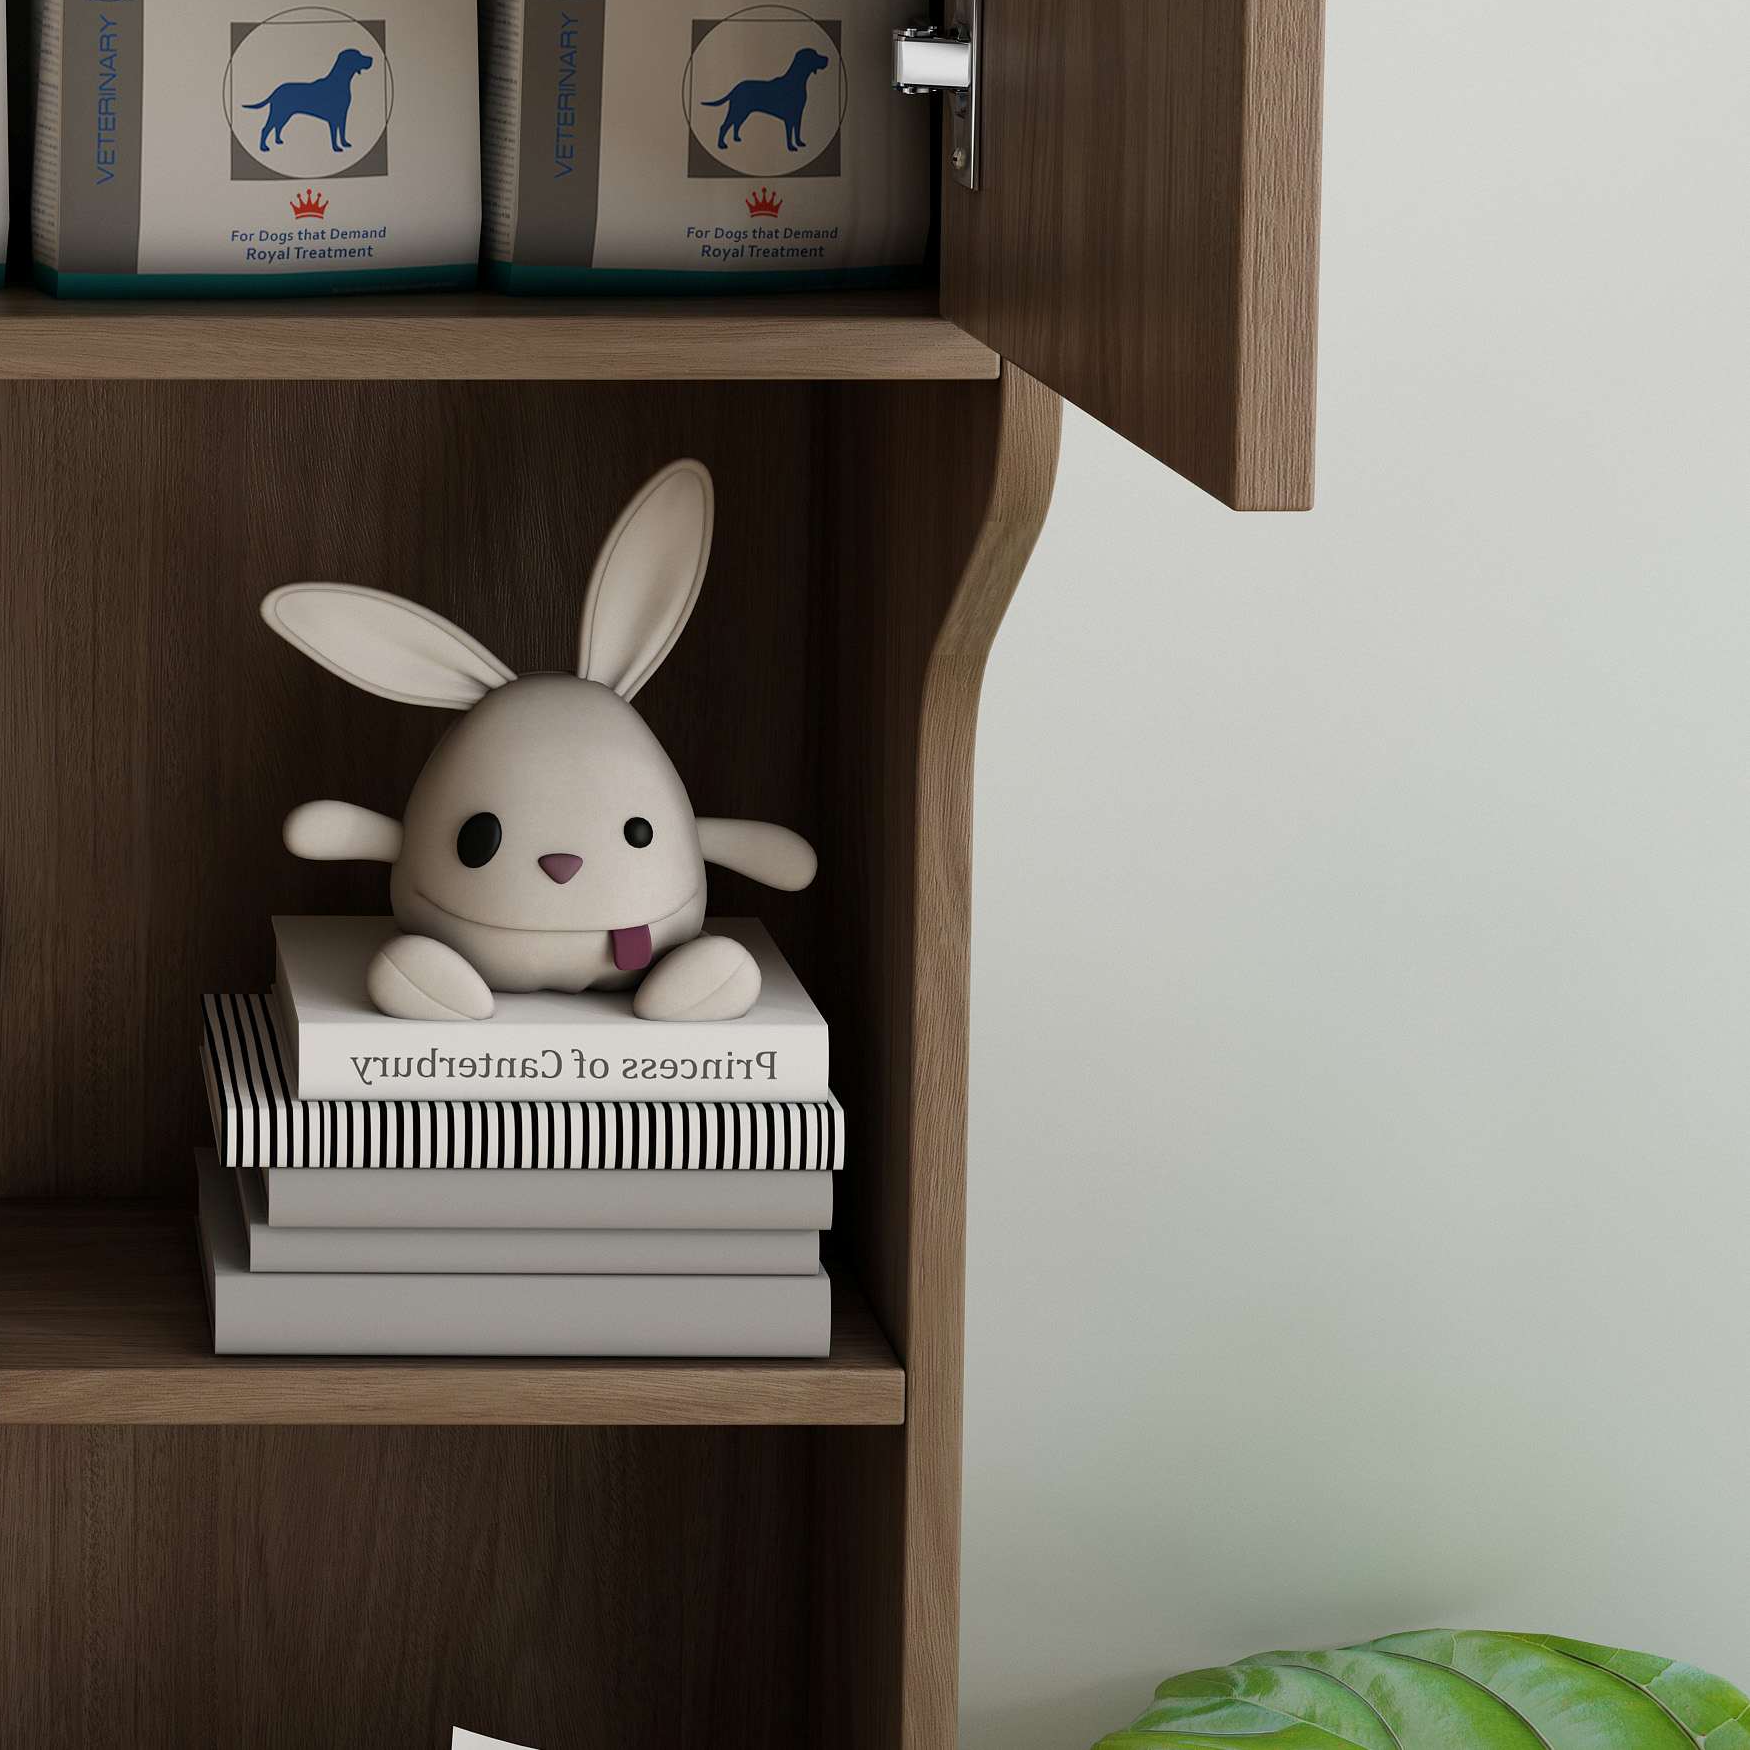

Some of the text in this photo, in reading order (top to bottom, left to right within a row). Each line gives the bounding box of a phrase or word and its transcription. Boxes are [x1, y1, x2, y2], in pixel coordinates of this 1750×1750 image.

[97, 14, 118, 185] VETERINARY
[554, 12, 578, 179] VETERINARY
[232, 227, 386, 244] For Dogs that Demand
[687, 226, 838, 242] For Dogs that Demand
[247, 245, 373, 263] Royal Treatment
[702, 245, 824, 261] Royal Treatment
